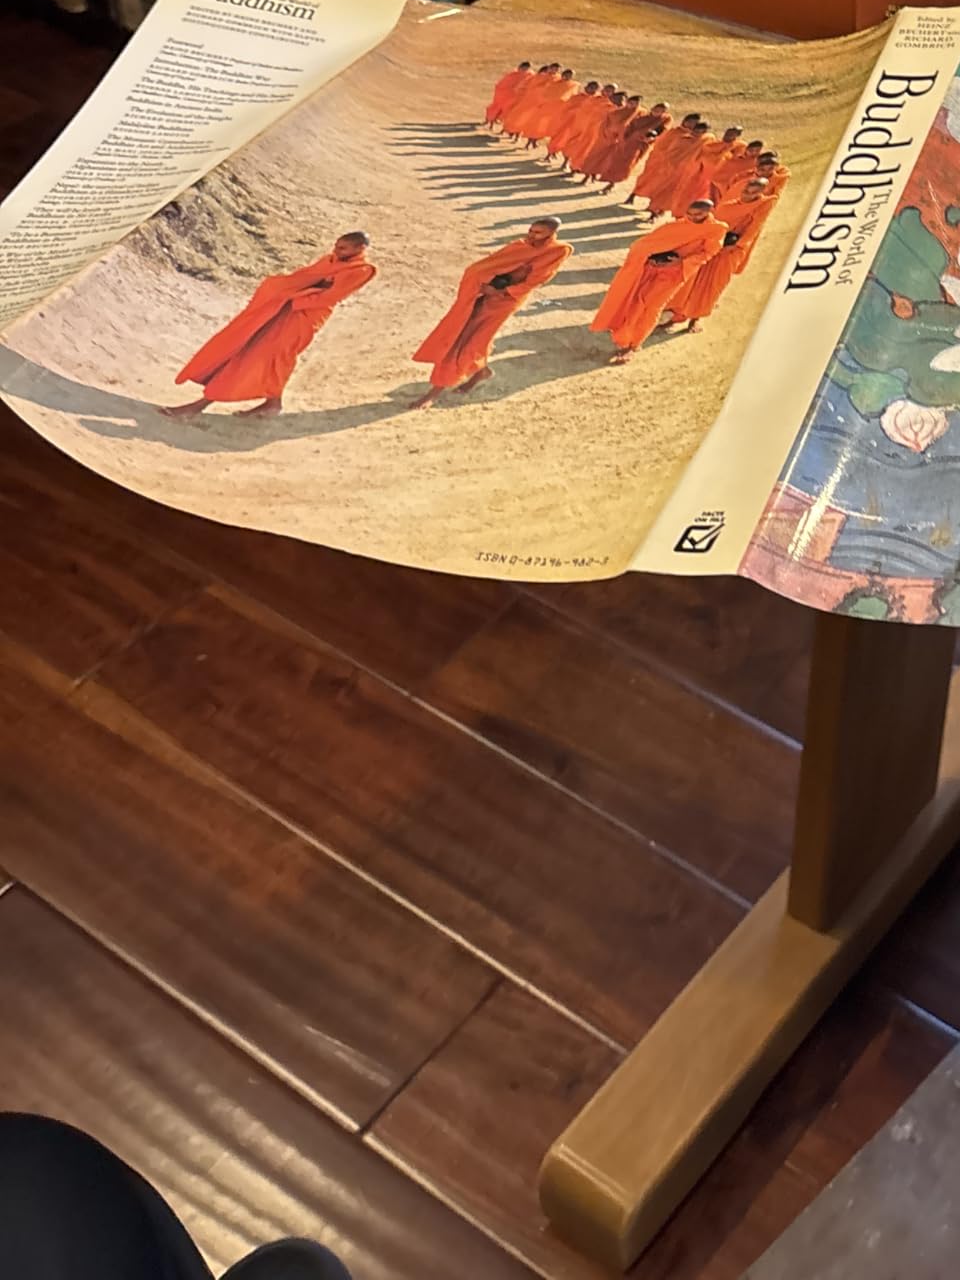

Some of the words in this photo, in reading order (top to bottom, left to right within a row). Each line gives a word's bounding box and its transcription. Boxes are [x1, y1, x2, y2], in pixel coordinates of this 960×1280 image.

[784, 70, 939, 293] Buddhism
[864, 188, 892, 220] The
[841, 220, 880, 268] World
[835, 272, 853, 286] of
[475, 551, 508, 564] ISBN
